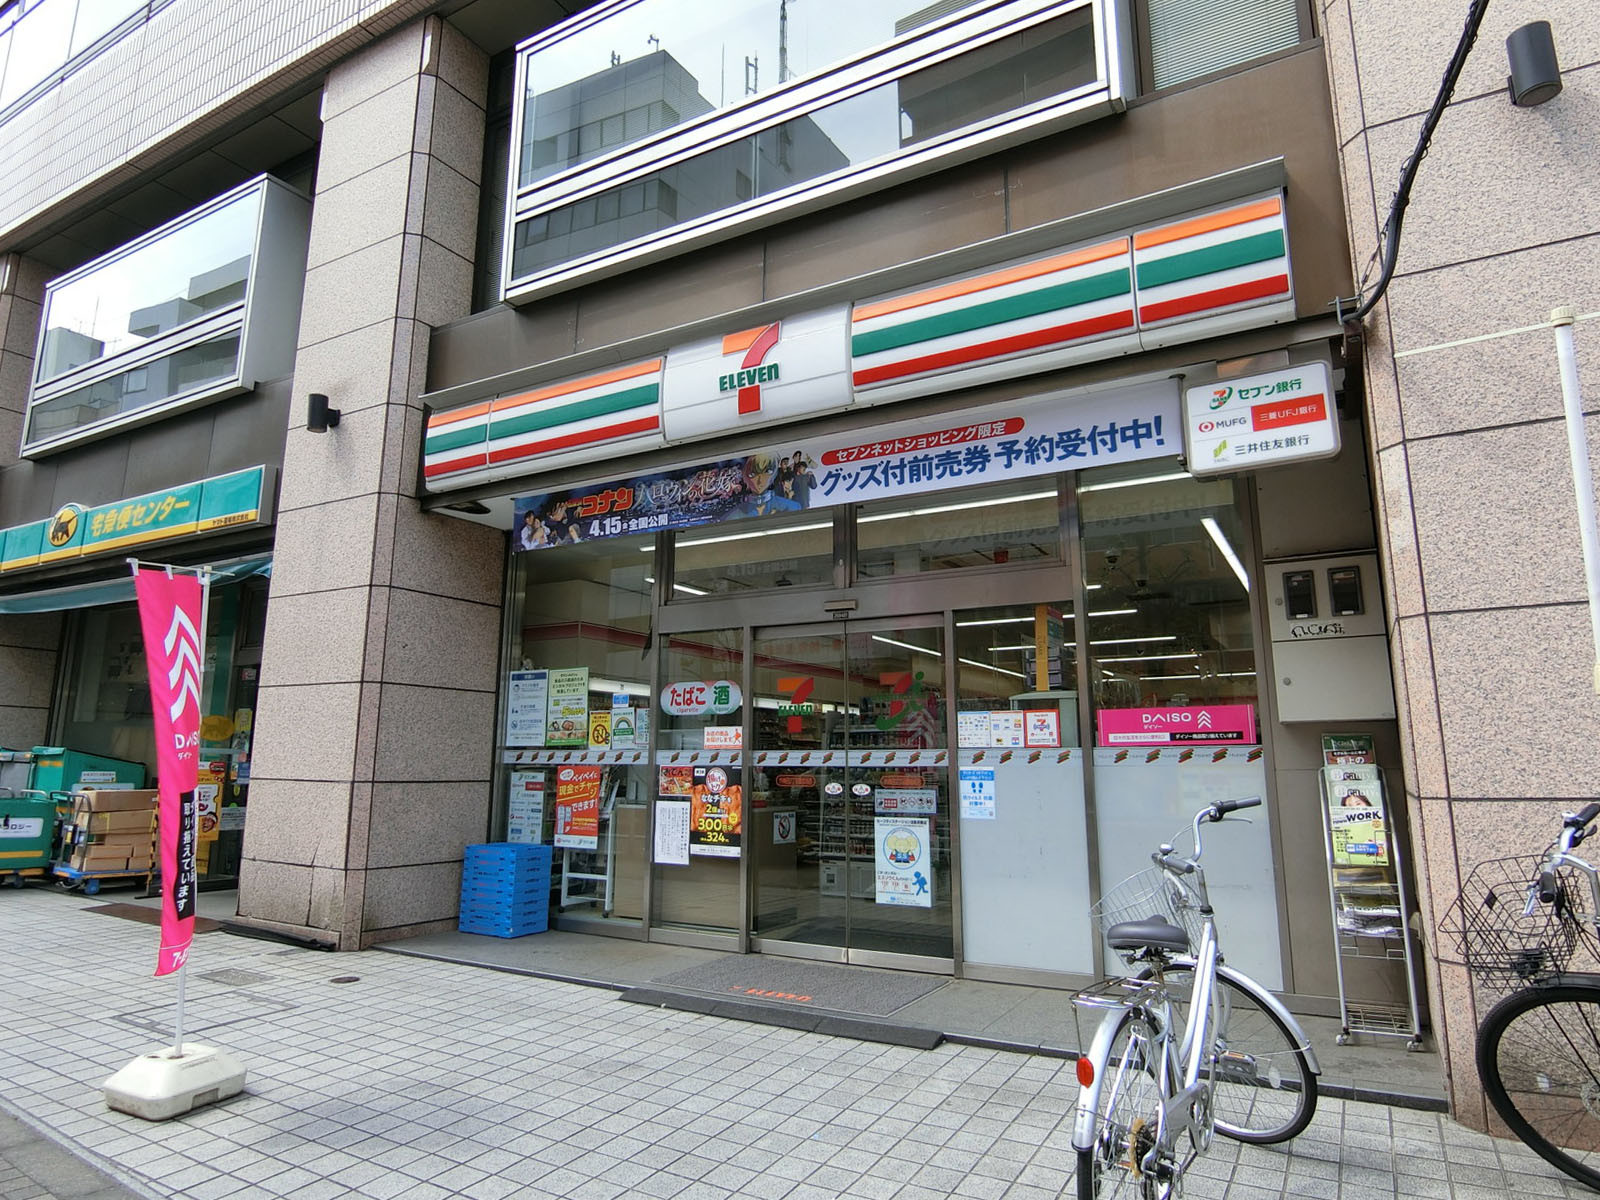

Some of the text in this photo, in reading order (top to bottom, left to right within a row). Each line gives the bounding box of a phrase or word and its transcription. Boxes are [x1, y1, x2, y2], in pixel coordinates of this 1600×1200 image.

[719, 362, 780, 392] ELEVEN
[1237, 378, 1303, 400] セブン銀行
[1215, 417, 1247, 429] MUFG
[1259, 405, 1318, 422] 三菱UFJ銀行
[836, 421, 1006, 462] セブンネットショッピング限定
[1235, 434, 1312, 456] 三井住友銀行
[632, 467, 740, 510] ハロウィンの花嫁
[580, 487, 634, 518] コナン
[90, 495, 190, 537] 宅急便センター
[670, 686, 706, 707] たばこ
[713, 685, 730, 705] 酒
[1142, 712, 1192, 723] DAISO
[1346, 810, 1383, 823] WORK
